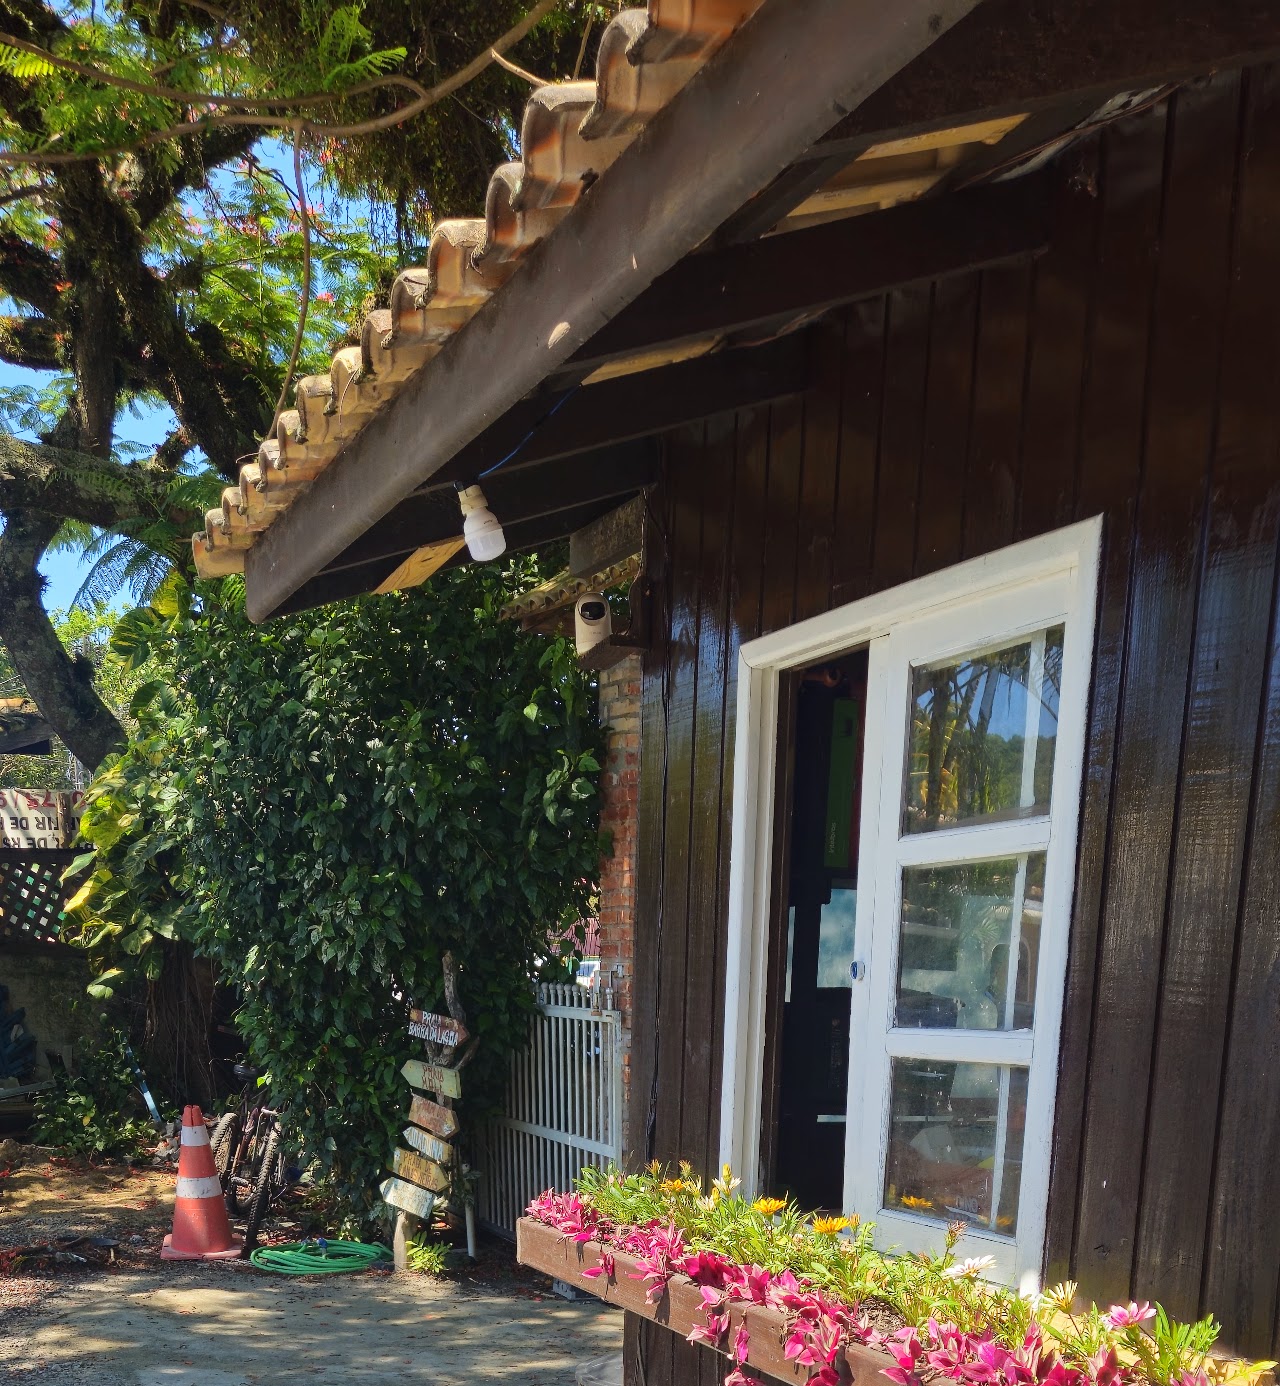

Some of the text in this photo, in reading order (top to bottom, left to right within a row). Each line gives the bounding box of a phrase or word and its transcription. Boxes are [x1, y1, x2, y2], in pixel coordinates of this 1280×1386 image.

[10, 816, 29, 830] DE
[422, 1011, 441, 1029] PRAIA
[408, 1021, 429, 1041] BARRA
[403, 1151, 422, 1169] PRAIA
